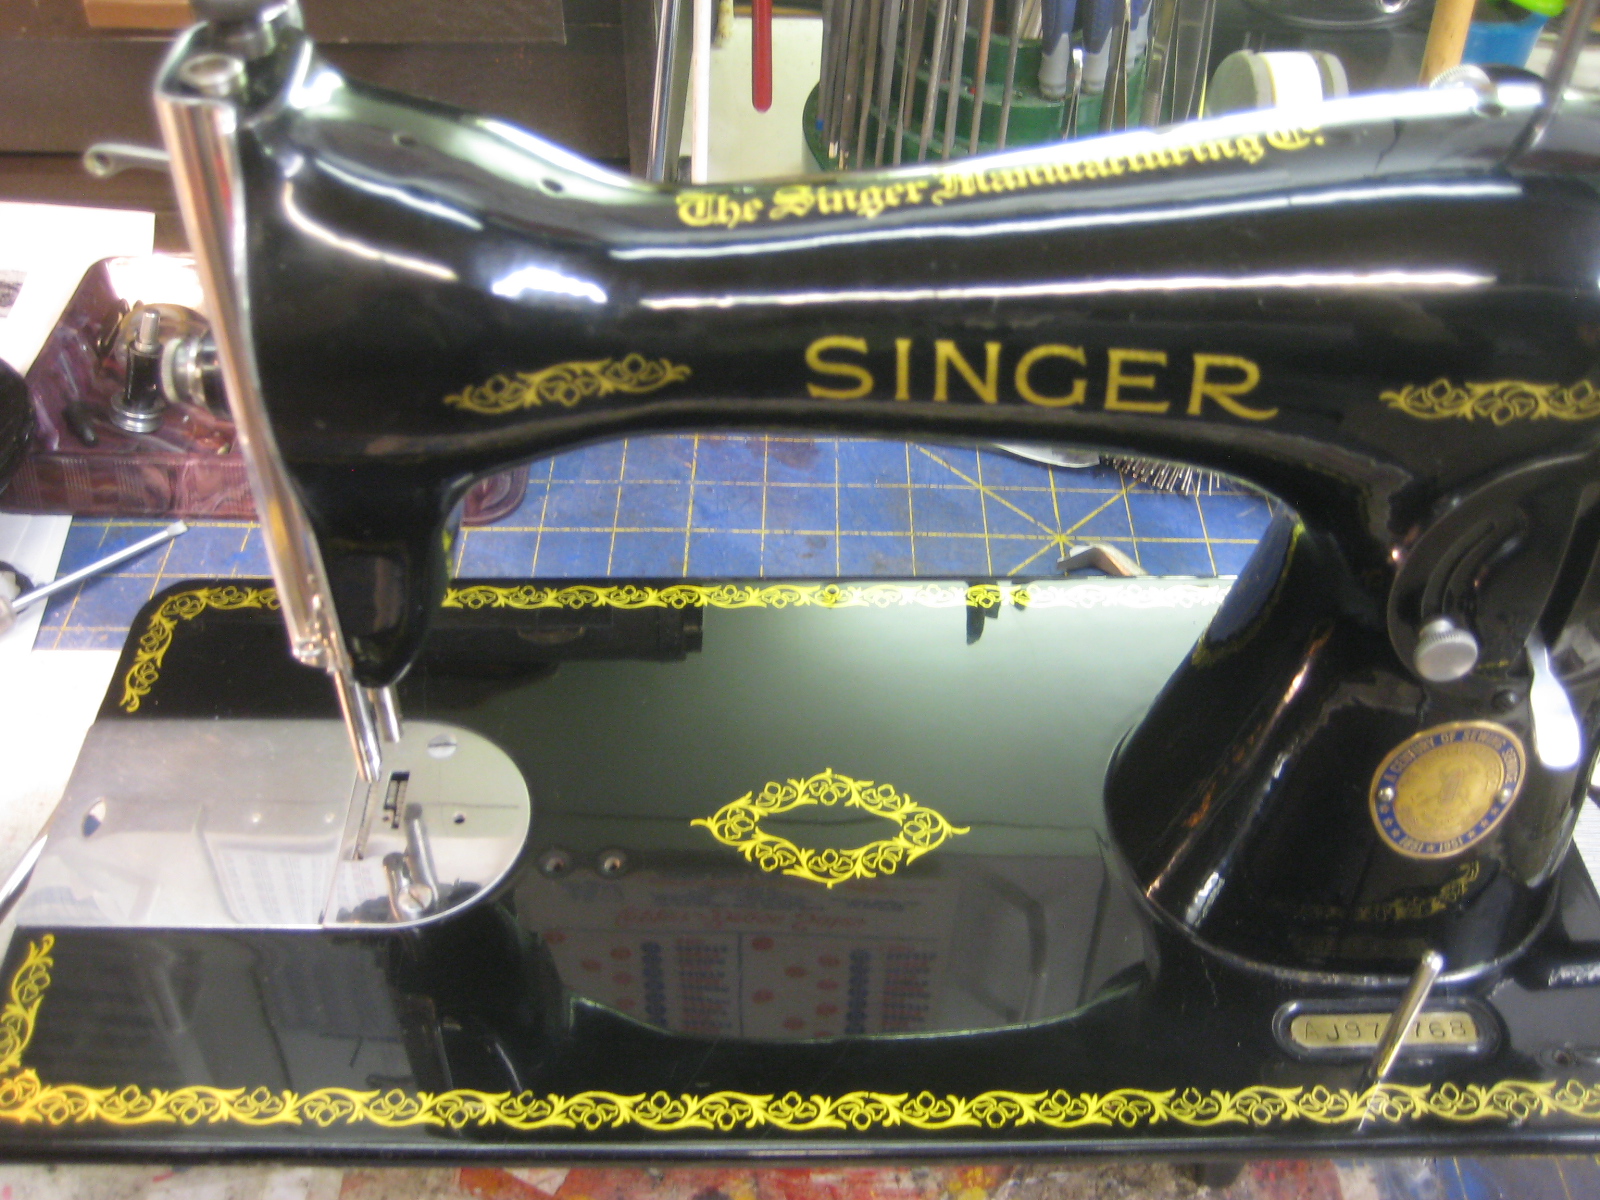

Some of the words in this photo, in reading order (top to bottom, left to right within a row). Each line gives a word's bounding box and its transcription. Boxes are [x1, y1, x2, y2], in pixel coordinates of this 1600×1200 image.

[677, 191, 764, 229] The
[769, 179, 929, 220] Singer
[805, 335, 1279, 421] SINGER
